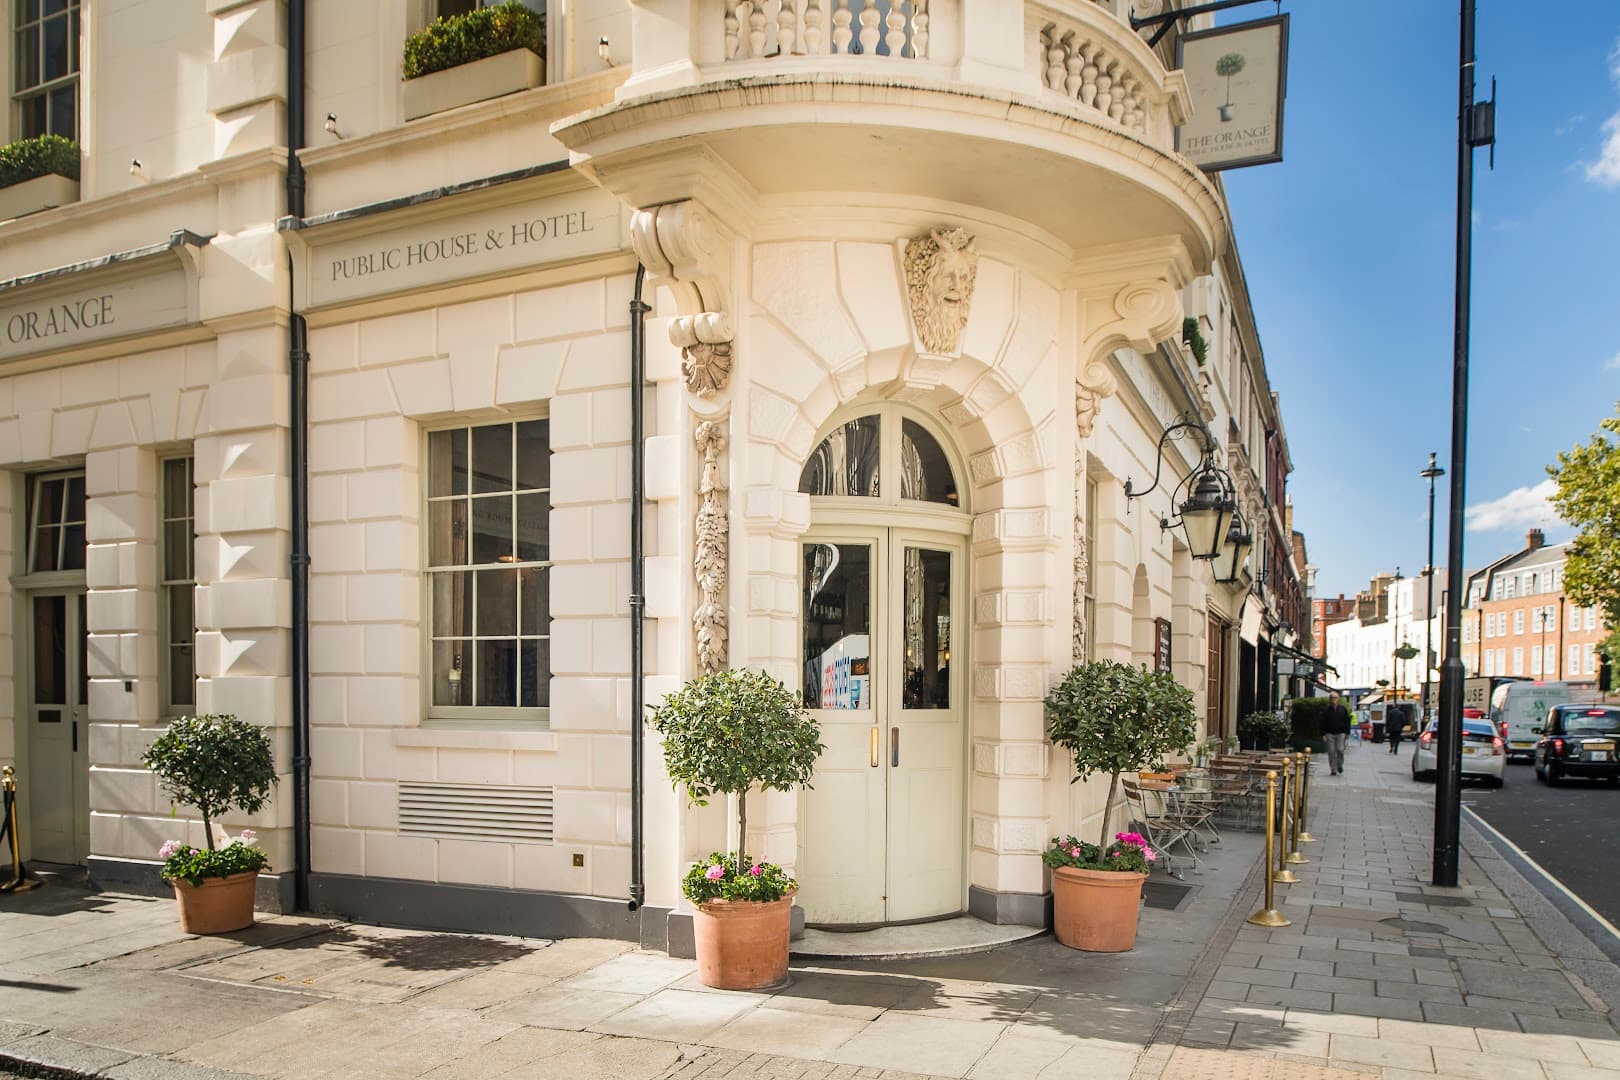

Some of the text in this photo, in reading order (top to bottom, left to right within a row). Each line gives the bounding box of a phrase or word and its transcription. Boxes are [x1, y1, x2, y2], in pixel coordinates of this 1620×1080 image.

[1185, 135, 1213, 149] THE
[1215, 124, 1271, 143] ORANGE
[331, 211, 594, 281] PUBLIC HOUSE & HOTEL
[7, 294, 115, 344] ORANGE
